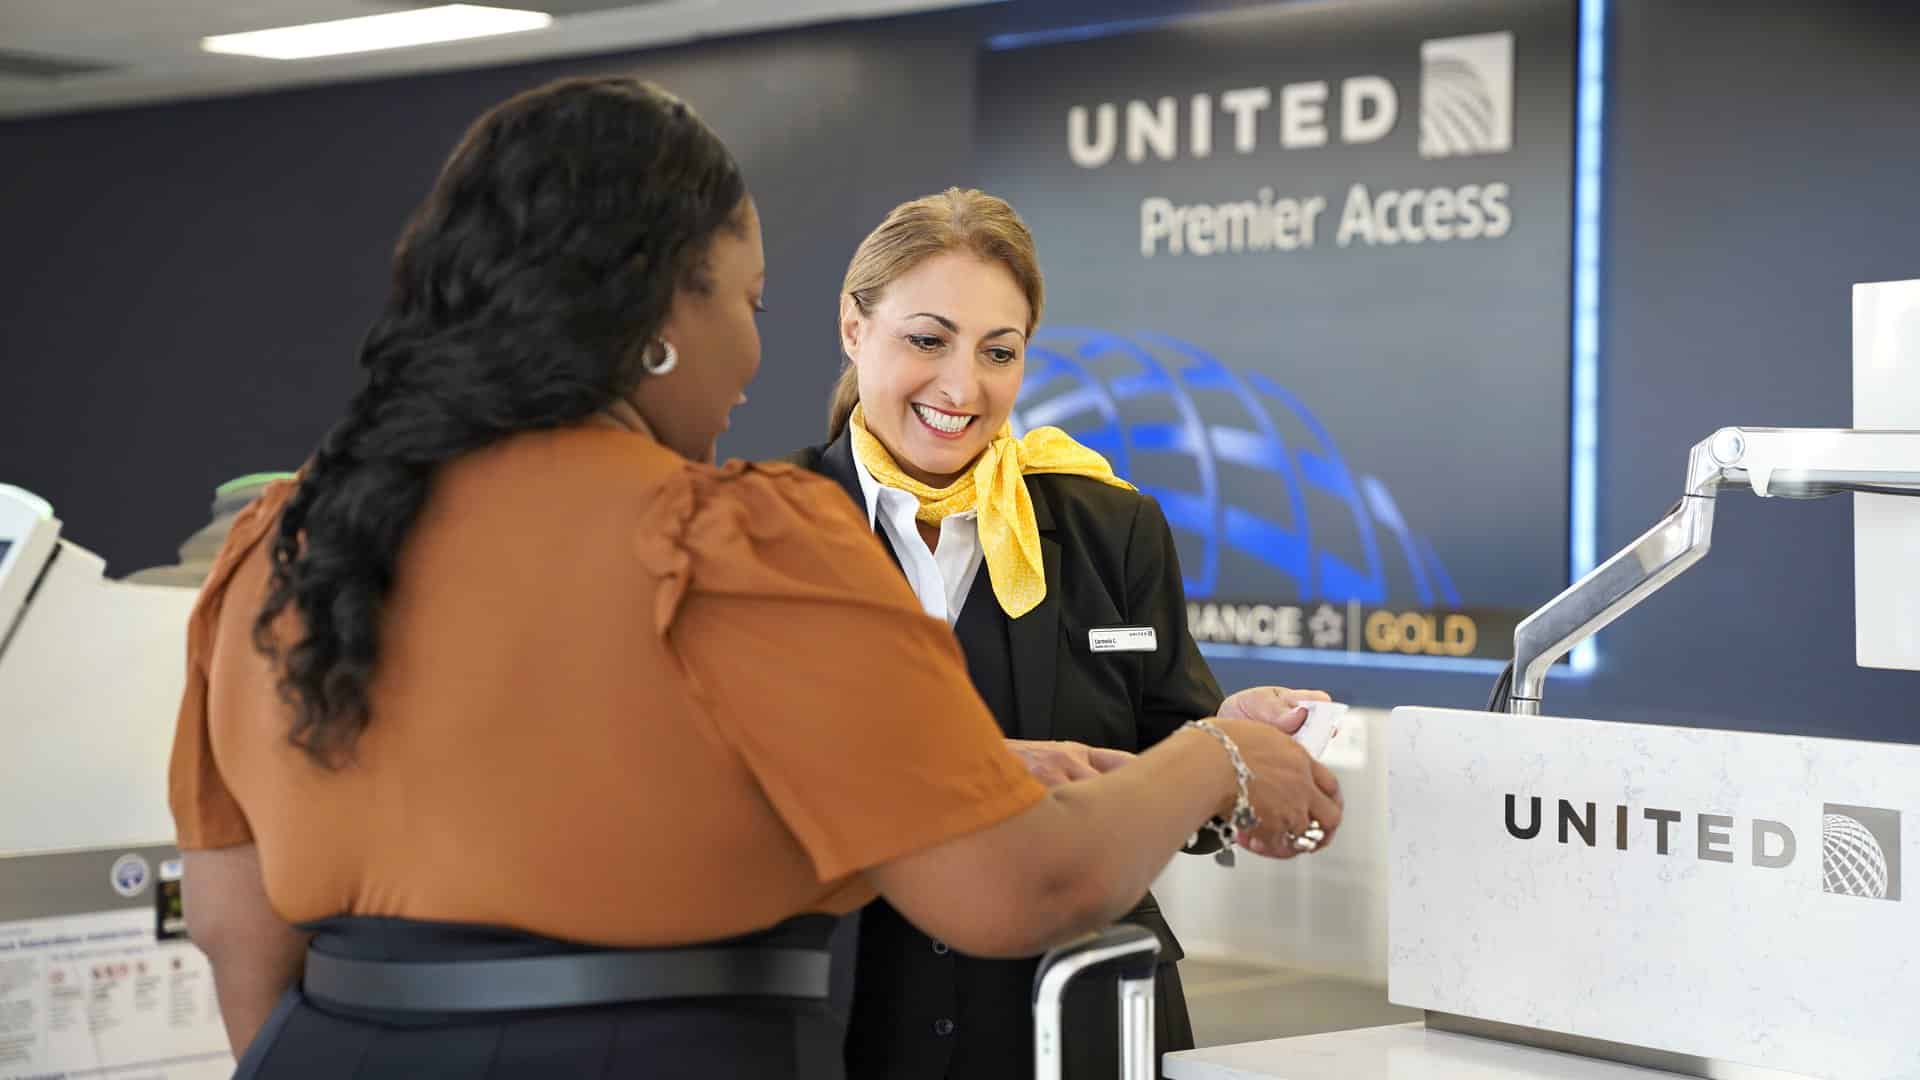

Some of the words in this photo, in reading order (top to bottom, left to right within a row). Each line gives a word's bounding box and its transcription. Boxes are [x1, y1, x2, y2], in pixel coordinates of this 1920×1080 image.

[1068, 75, 1398, 167] UNITED
[1140, 187, 1325, 258] Premier
[1336, 182, 1511, 248] Access
[1365, 609, 1478, 657] GOLD
[1504, 794, 1797, 869] UNITED
